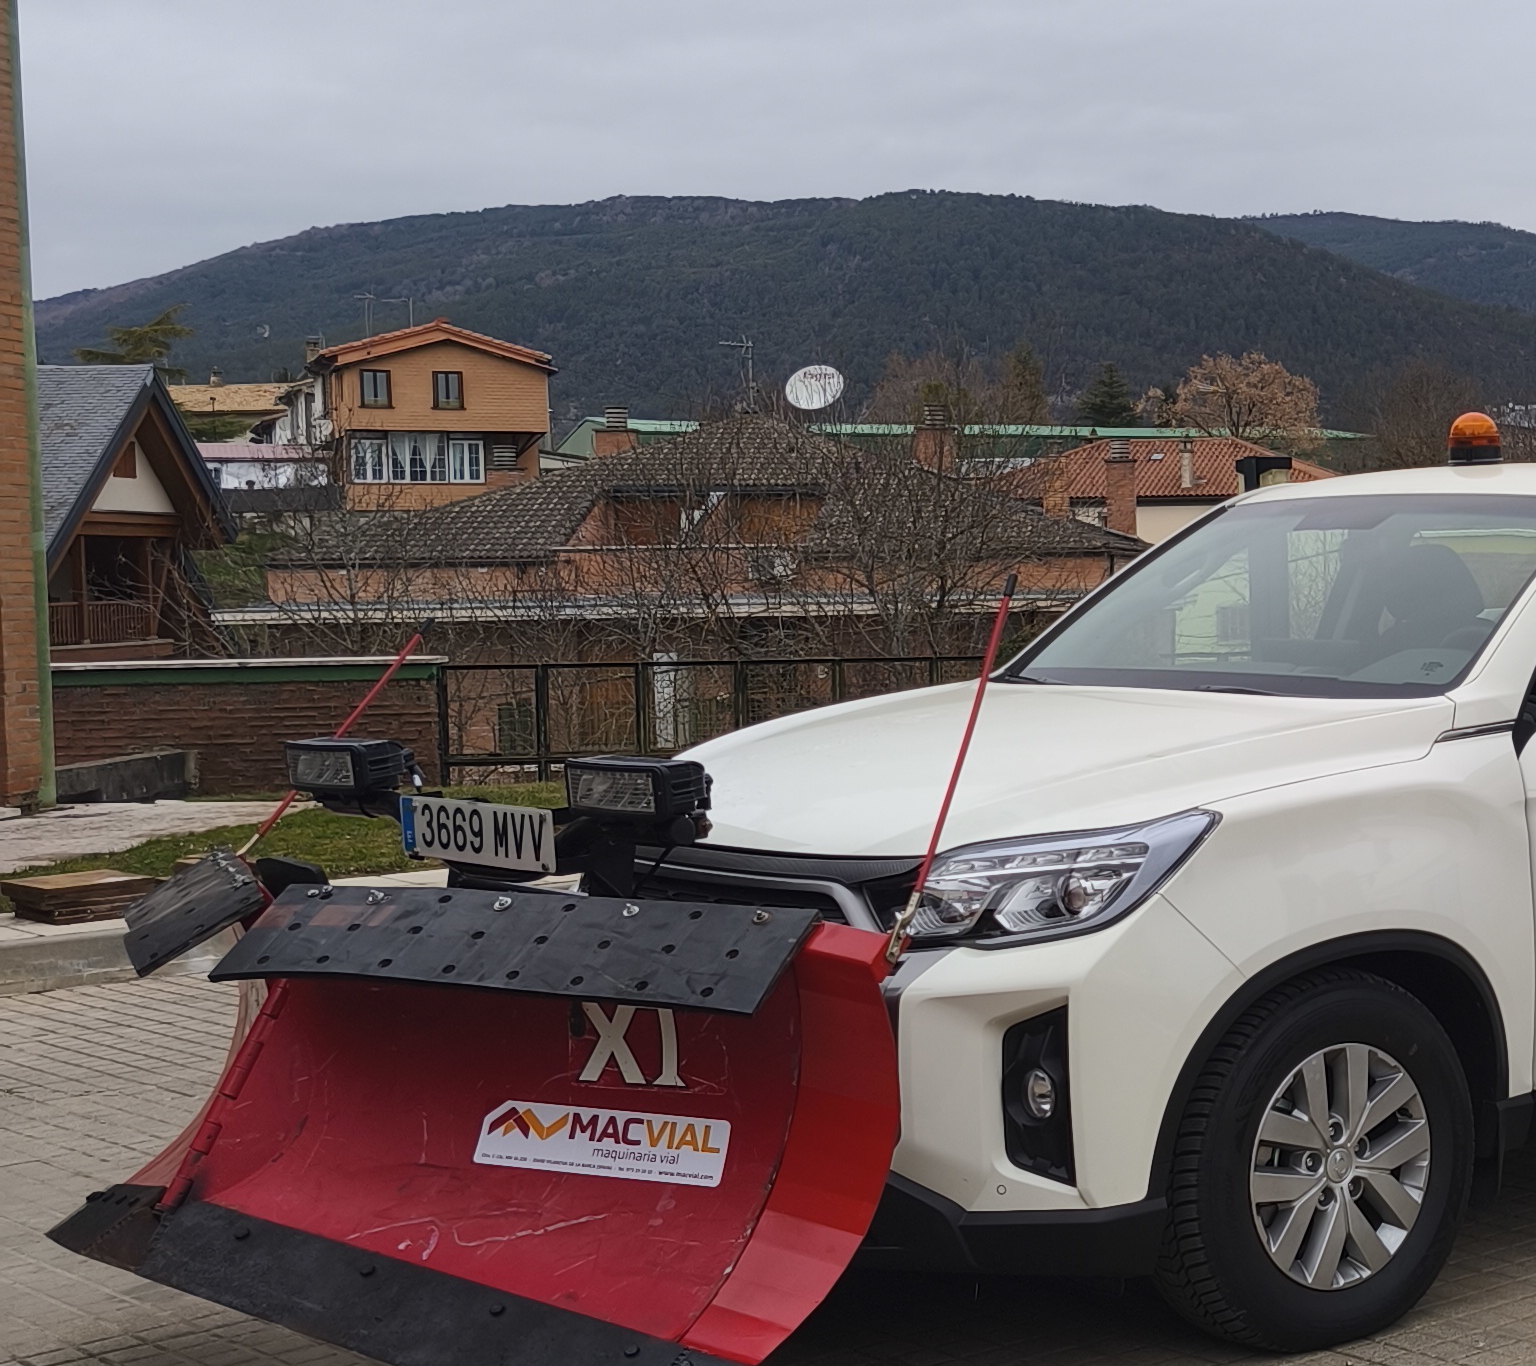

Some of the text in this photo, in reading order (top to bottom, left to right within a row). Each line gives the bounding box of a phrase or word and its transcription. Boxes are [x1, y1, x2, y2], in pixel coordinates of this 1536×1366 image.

[421, 803, 544, 862] 3669 MVV
[568, 1112, 721, 1154] MACVIAL
[591, 1147, 680, 1165] maquinaria vial
